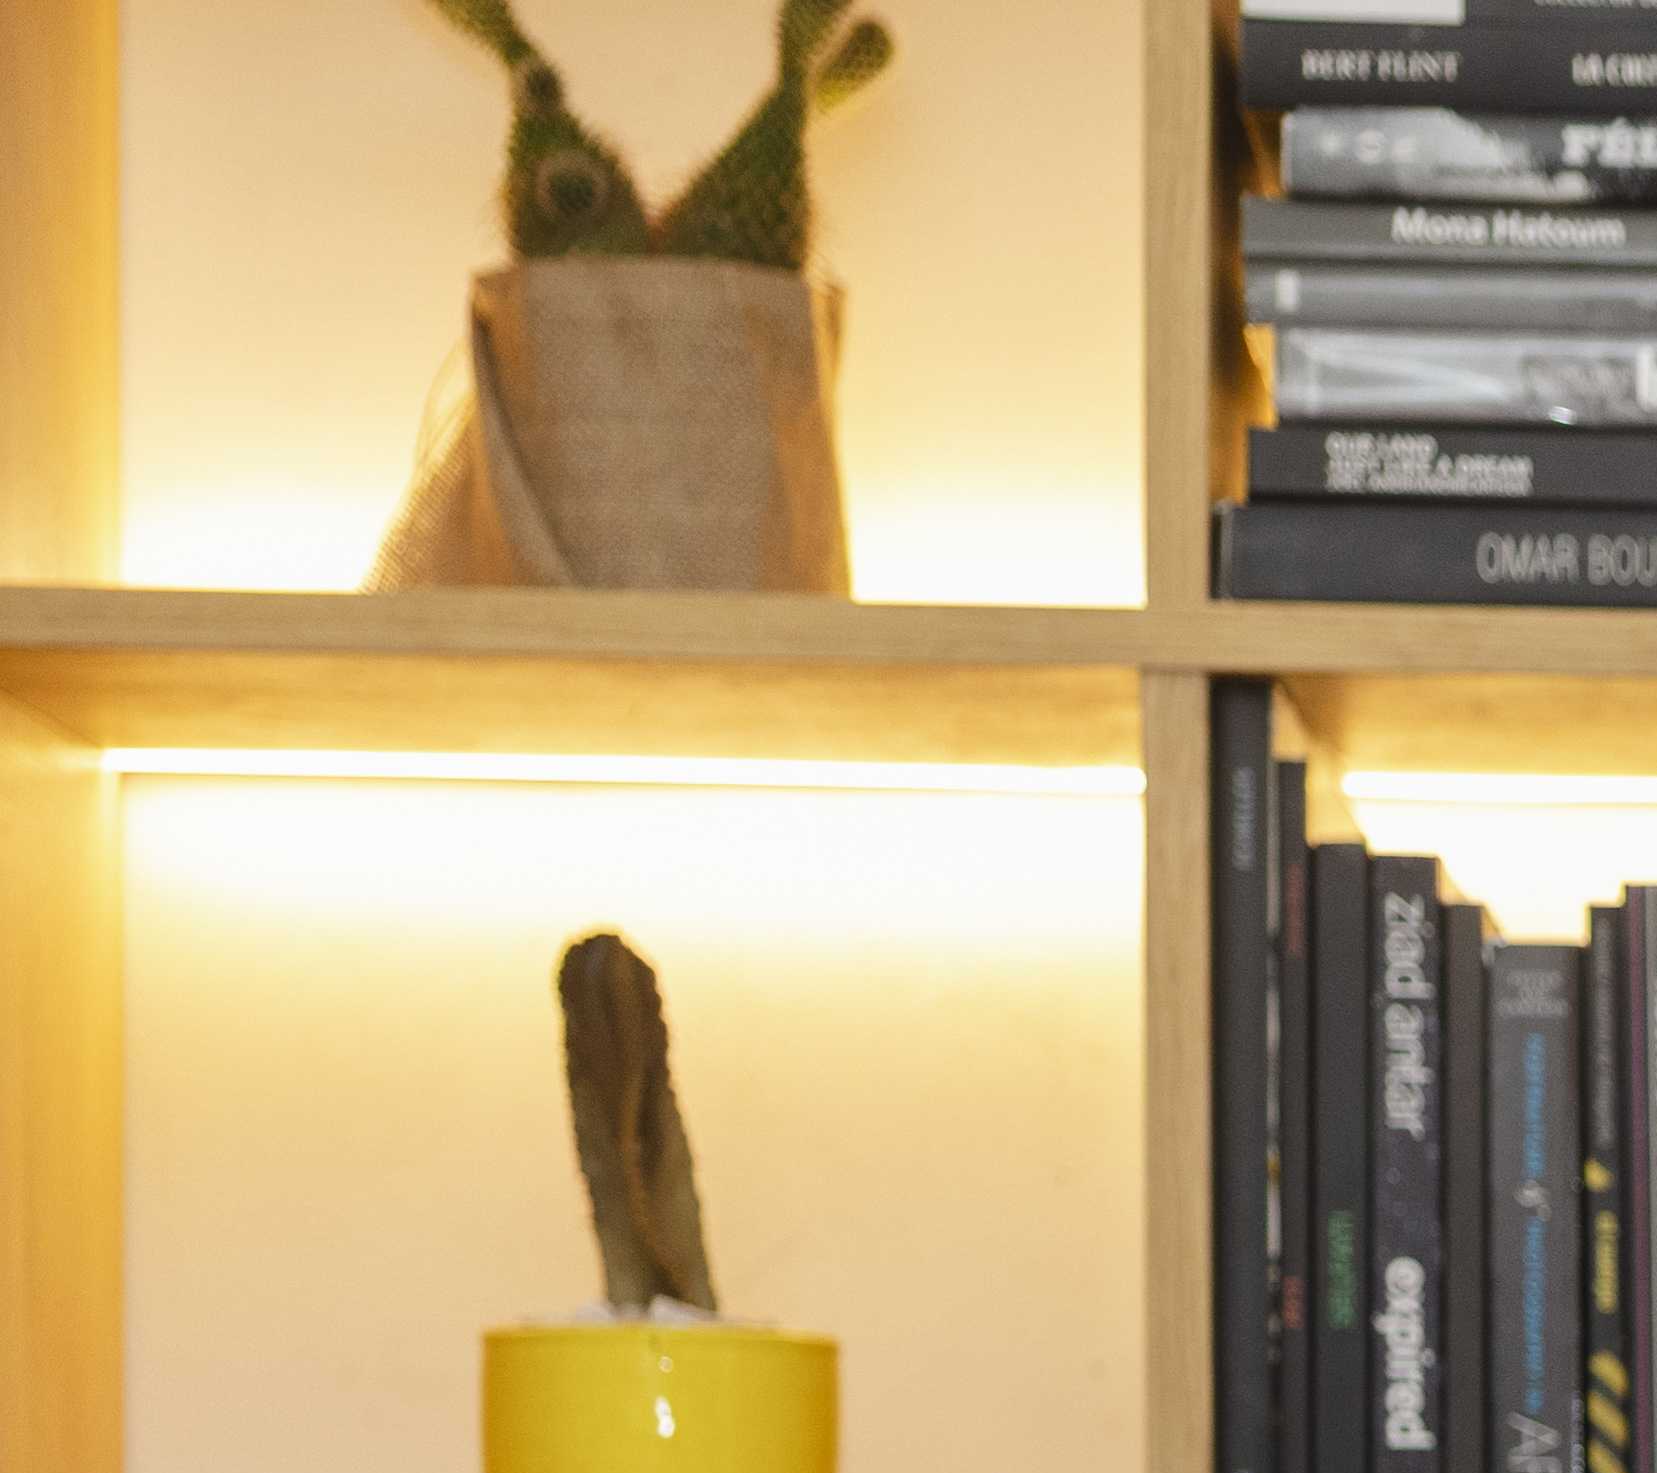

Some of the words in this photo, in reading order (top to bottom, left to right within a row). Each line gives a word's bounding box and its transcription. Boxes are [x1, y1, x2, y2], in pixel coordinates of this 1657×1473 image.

[1301, 52, 1370, 83] BERT
[1378, 52, 1459, 83] FLINT
[1393, 211, 1484, 247] Mona
[1493, 212, 1625, 250] Hatoum
[1478, 533, 1580, 583] OMAR
[1385, 892, 1438, 1003] ziad
[1386, 1006, 1438, 1140] antar
[1376, 1256, 1437, 1449] expired
